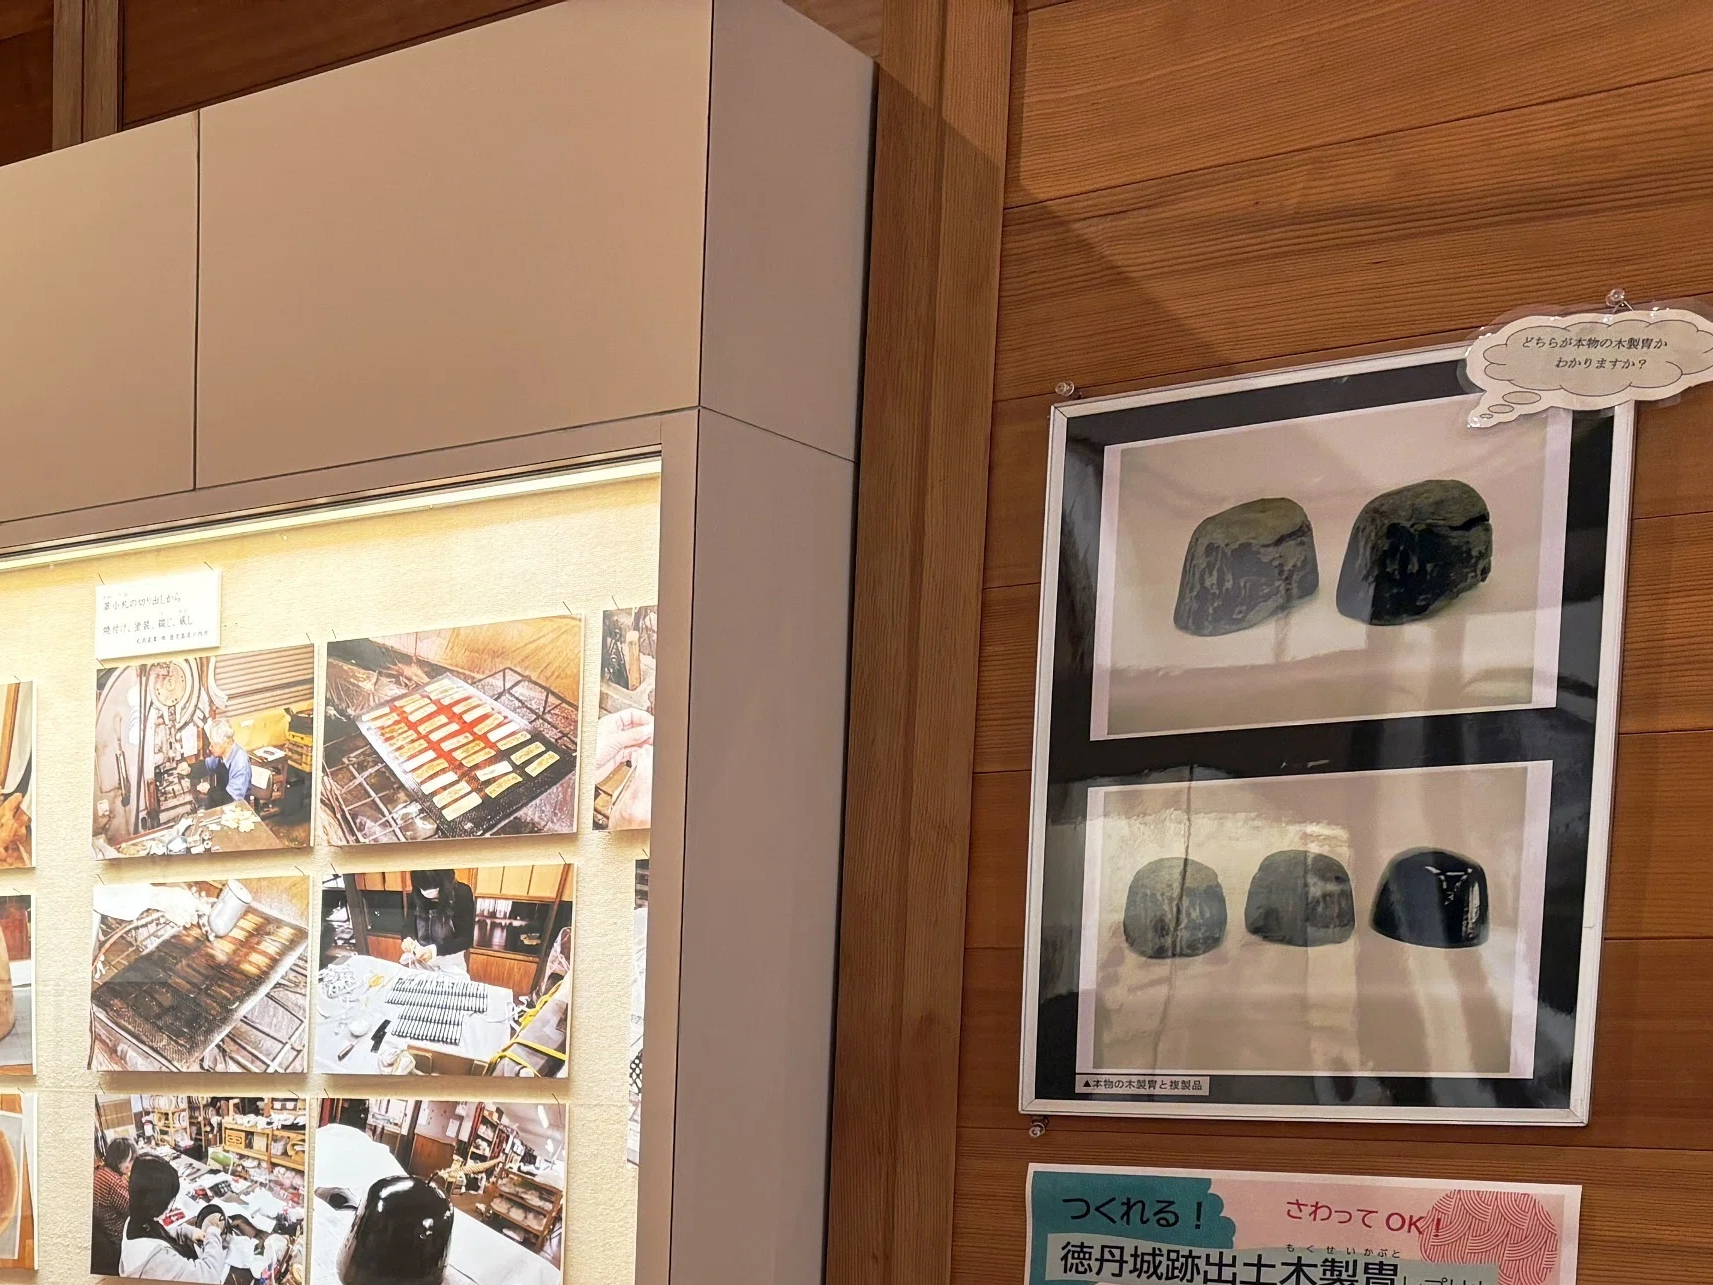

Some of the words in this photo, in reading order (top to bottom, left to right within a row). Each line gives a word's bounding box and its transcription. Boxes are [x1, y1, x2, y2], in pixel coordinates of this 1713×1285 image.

[1522, 336, 1668, 350] どちらが本物の木製冑か
[1555, 358, 1647, 370] わかりますか？
[1062, 1196, 1203, 1230] つくれる！
[1286, 1198, 1378, 1229] さわって
